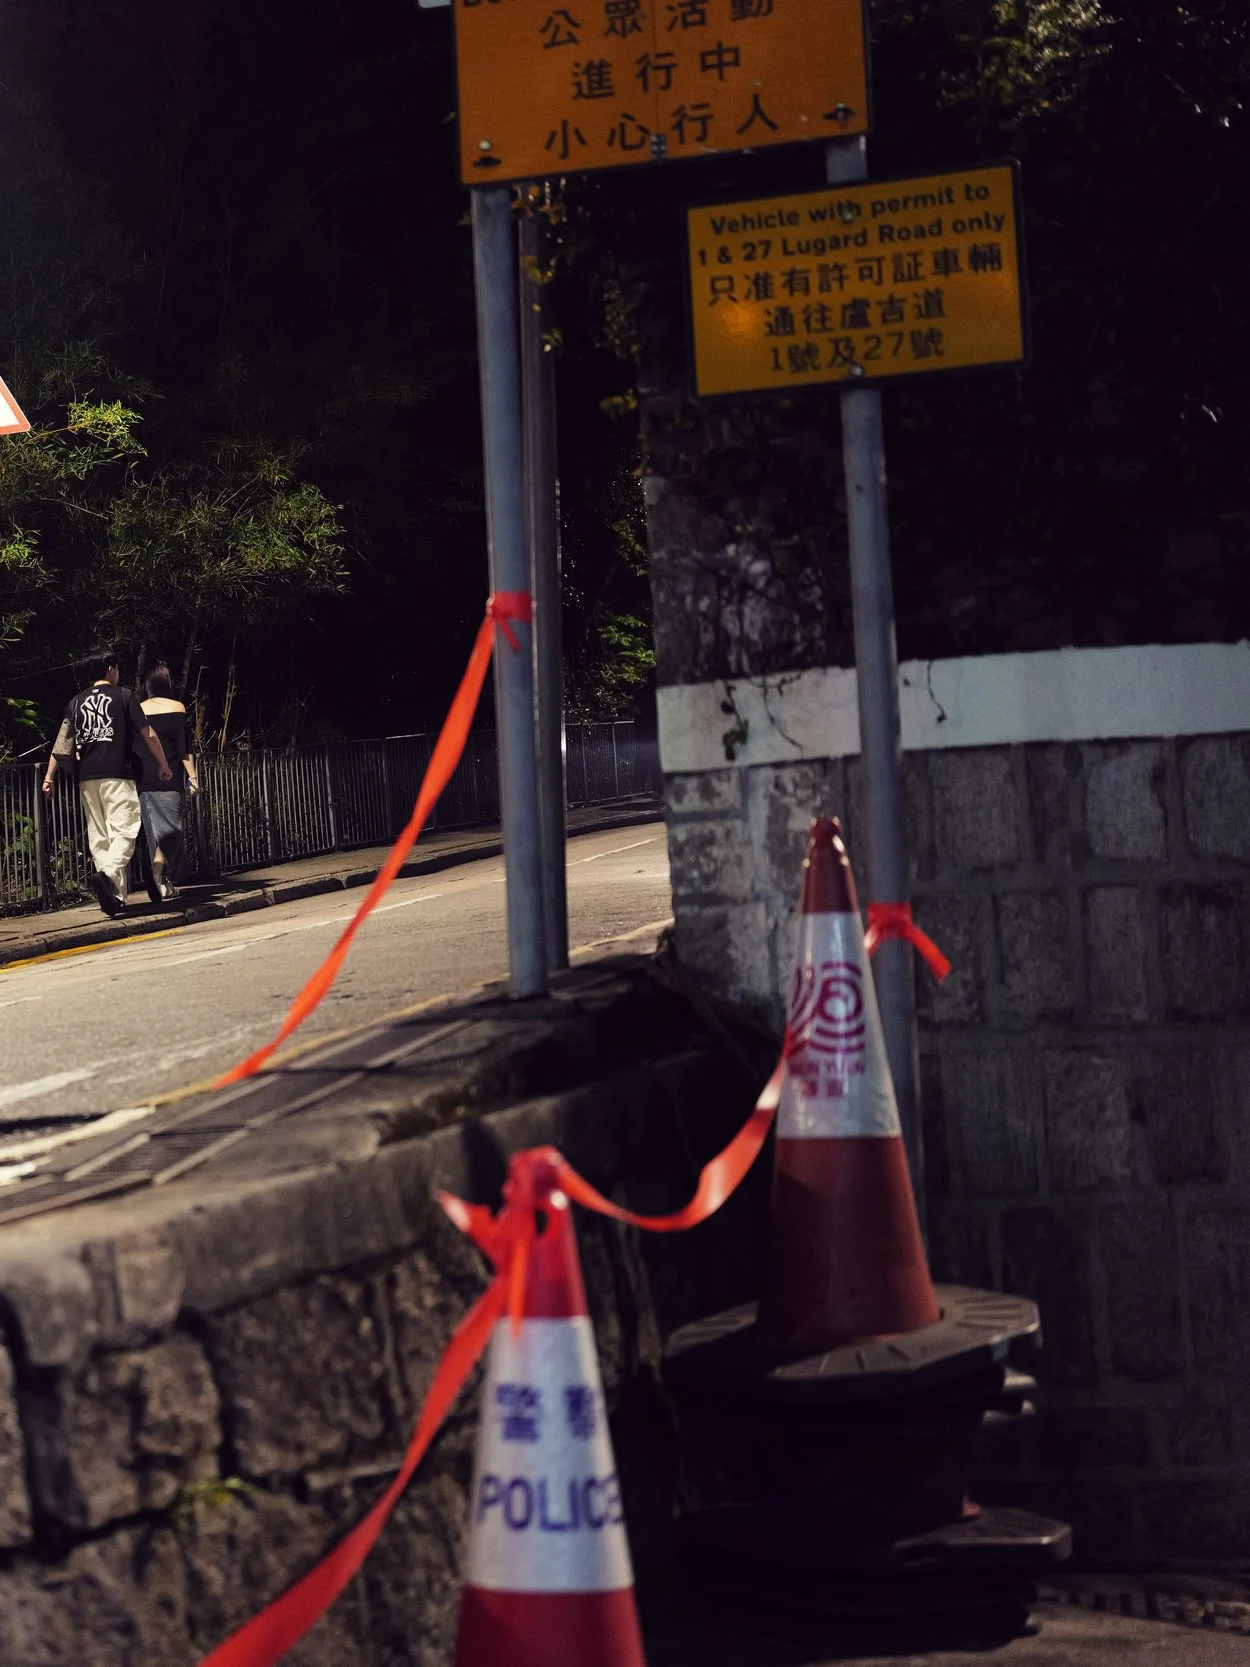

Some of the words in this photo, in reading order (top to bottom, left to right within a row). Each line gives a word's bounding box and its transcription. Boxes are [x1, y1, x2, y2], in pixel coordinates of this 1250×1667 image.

[572, 40, 741, 101] 進行中
[544, 93, 780, 160] 小心行人
[710, 208, 800, 236] Vehicle
[808, 199, 862, 226] with
[871, 185, 955, 219] permit
[965, 182, 990, 203] to
[698, 247, 708, 267] 1
[717, 245, 733, 265] &
[741, 240, 772, 261] 27
[781, 227, 868, 257] Lugard
[879, 217, 944, 244] Road
[952, 210, 1005, 234] only
[764, 286, 946, 338] 通往盧古道
